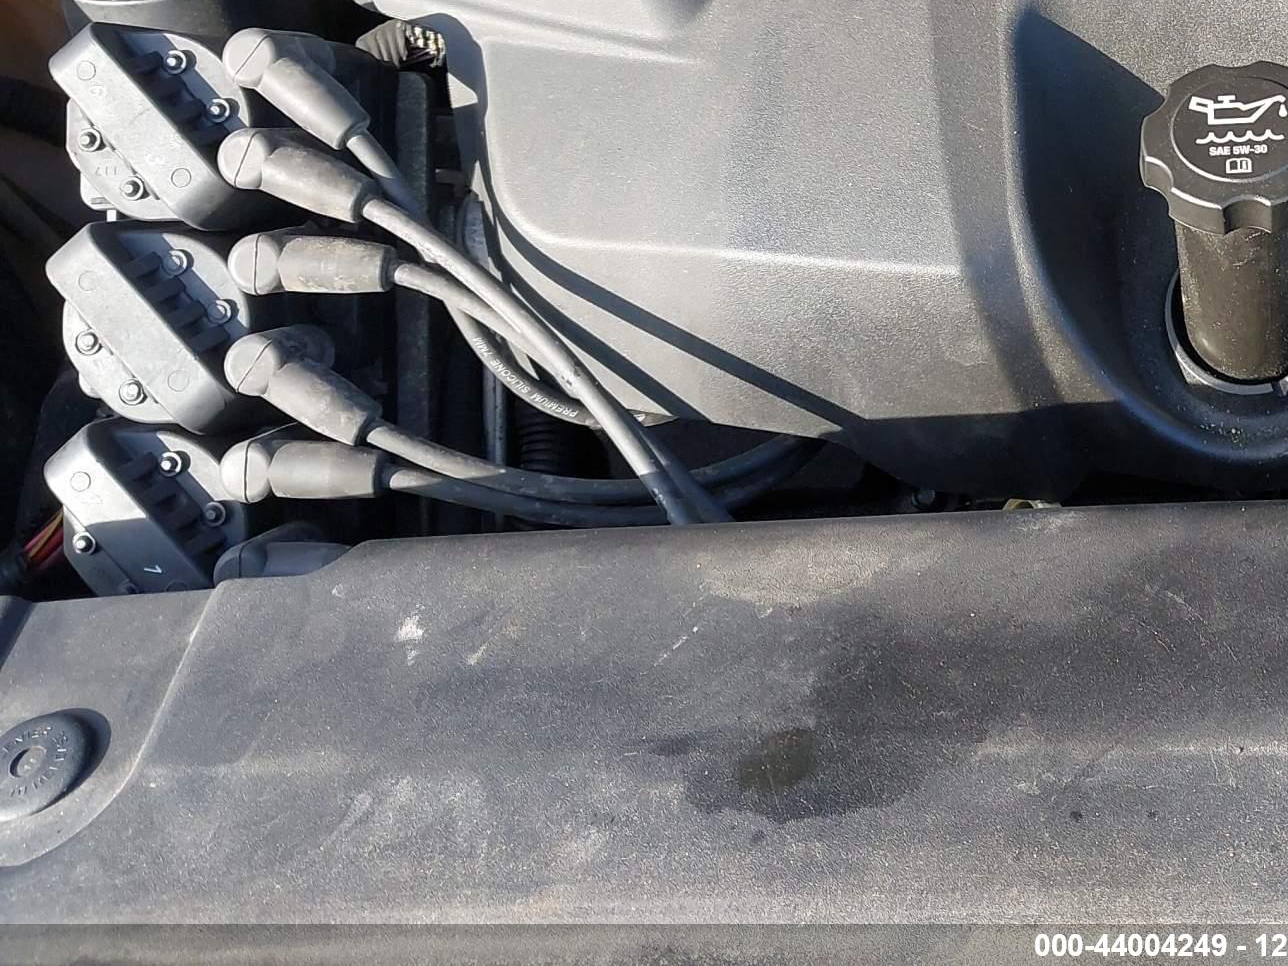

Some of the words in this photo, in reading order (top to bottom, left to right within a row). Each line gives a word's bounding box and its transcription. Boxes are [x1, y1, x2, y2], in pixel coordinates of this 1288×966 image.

[1209, 145, 1231, 156] SAE
[1232, 144, 1268, 155] 5W-30
[472, 336, 493, 358] 7MM
[490, 358, 531, 394] SILICONE
[530, 393, 579, 417] PREMIUM
